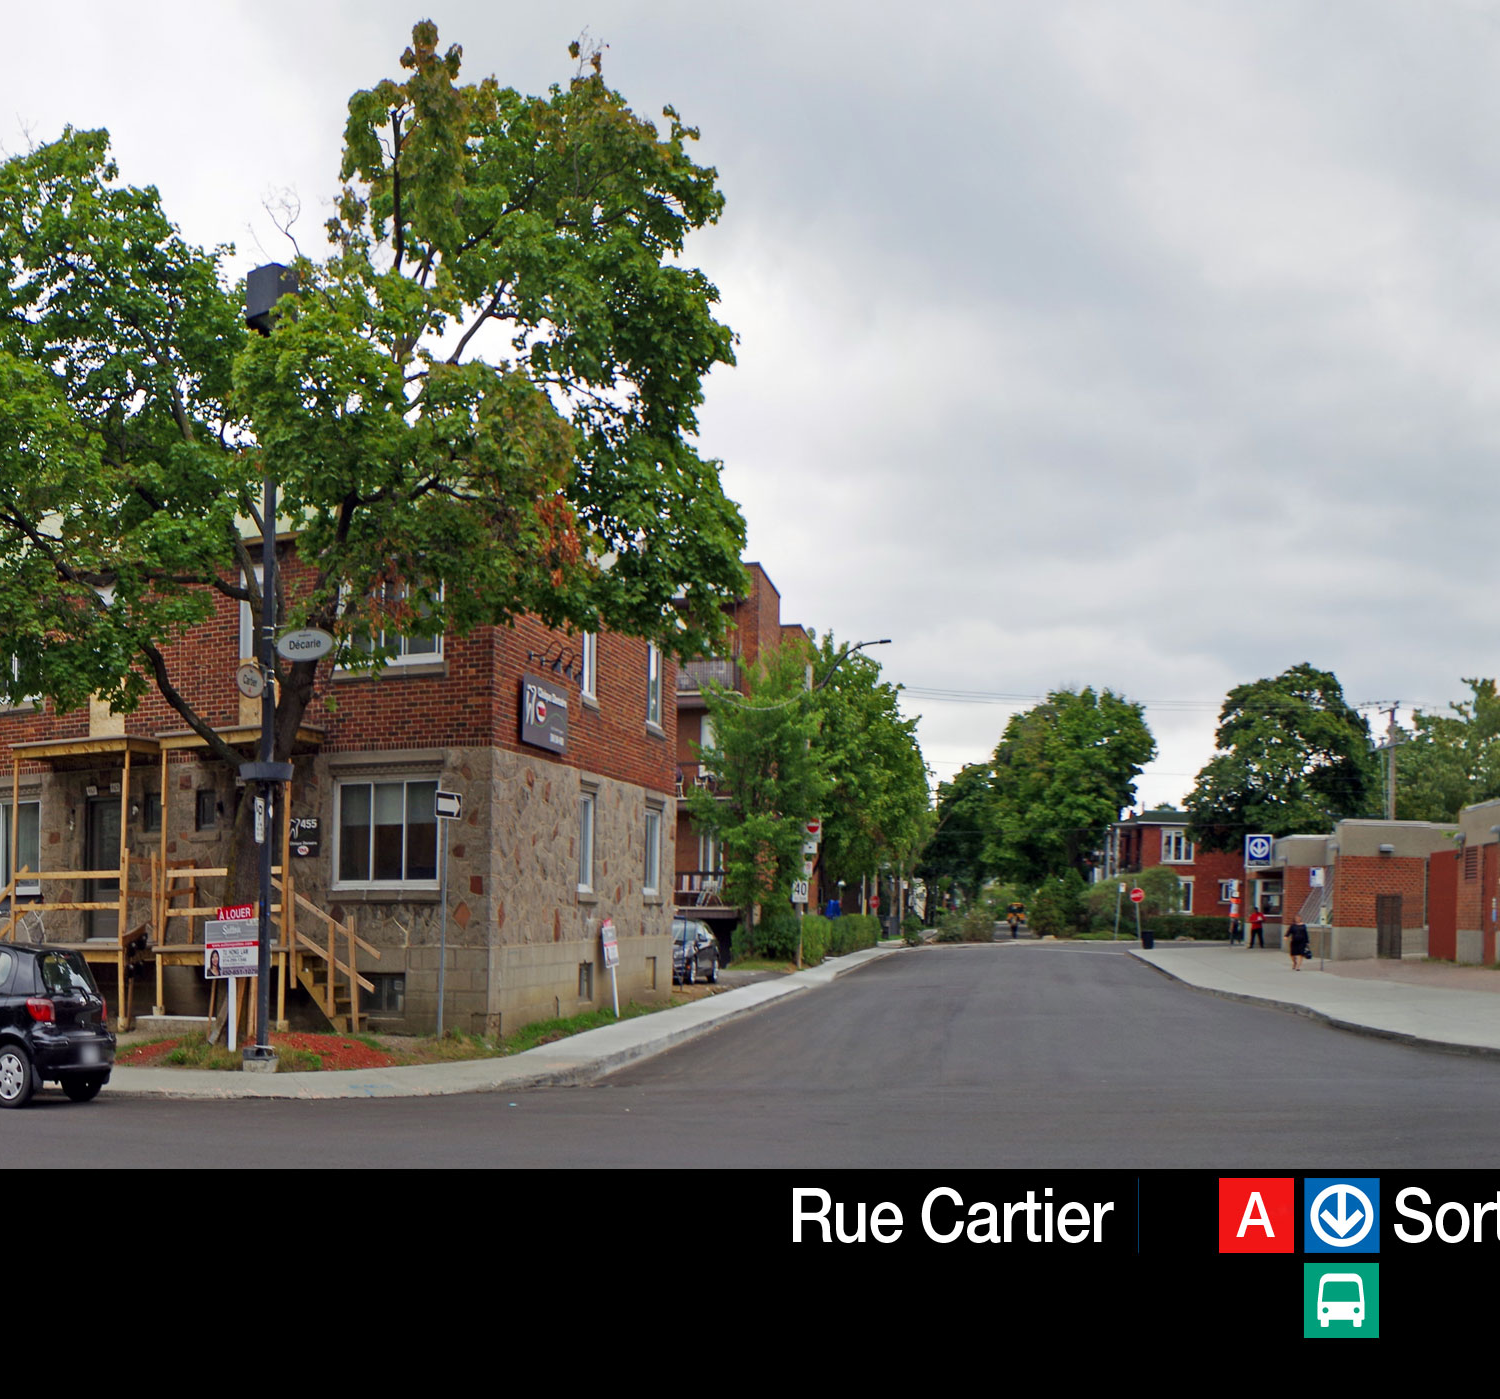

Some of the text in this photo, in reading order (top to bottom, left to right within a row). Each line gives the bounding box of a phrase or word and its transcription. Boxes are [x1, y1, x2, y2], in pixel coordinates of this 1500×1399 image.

[289, 639, 321, 650] Décarie
[243, 675, 258, 687] Cartier
[300, 819, 317, 829] 455
[795, 883, 807, 896] 40
[218, 907, 251, 920] À LOUER
